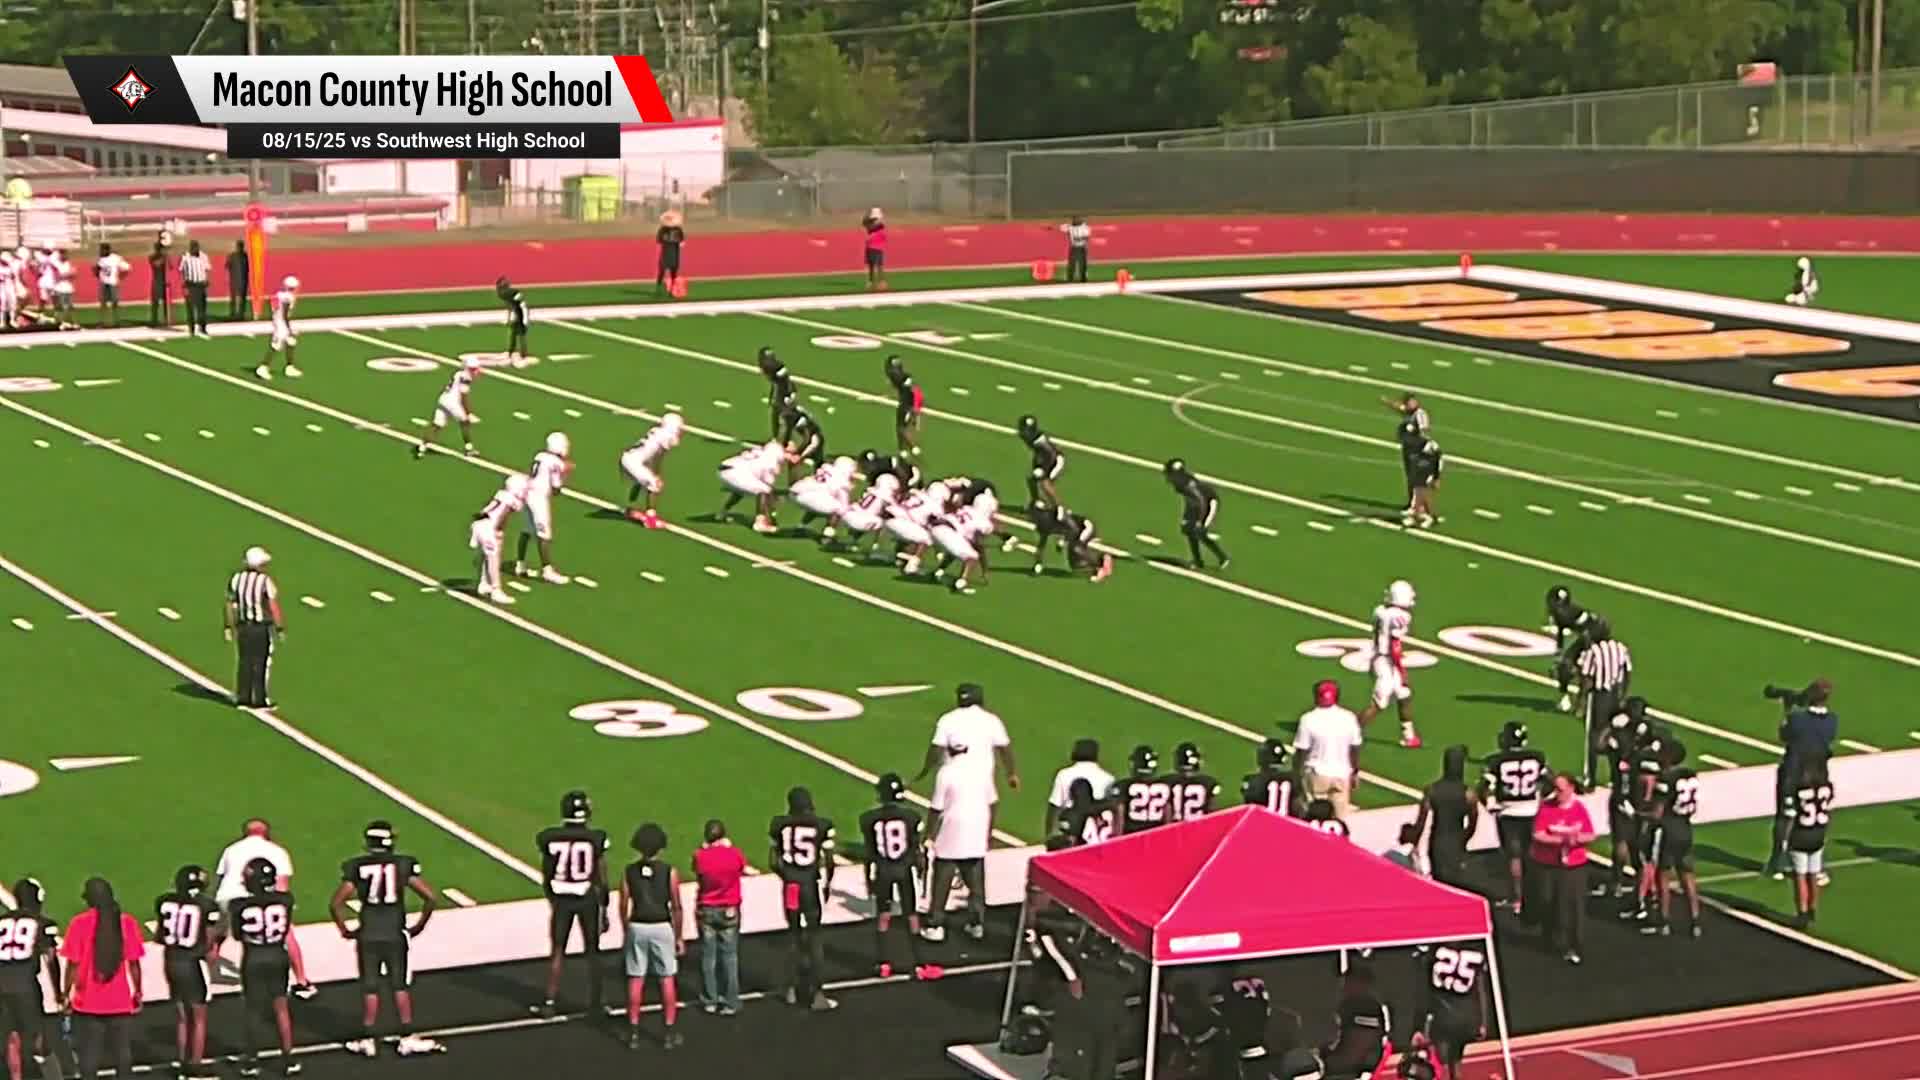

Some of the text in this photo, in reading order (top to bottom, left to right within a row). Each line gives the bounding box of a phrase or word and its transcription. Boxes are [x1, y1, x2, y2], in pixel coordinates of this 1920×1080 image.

[569, 687, 864, 739] 30
[1267, 780, 1291, 817] 11
[1501, 760, 1540, 796] 52
[1128, 783, 1169, 821] 22
[1172, 784, 1206, 821] 12
[781, 825, 817, 866] 15
[873, 819, 907, 860] 18
[549, 841, 593, 881] 70
[359, 863, 397, 904] 71
[0, 917, 38, 962] 29
[160, 902, 200, 947] 30
[241, 904, 287, 944] 28
[1432, 946, 1483, 993] 25
